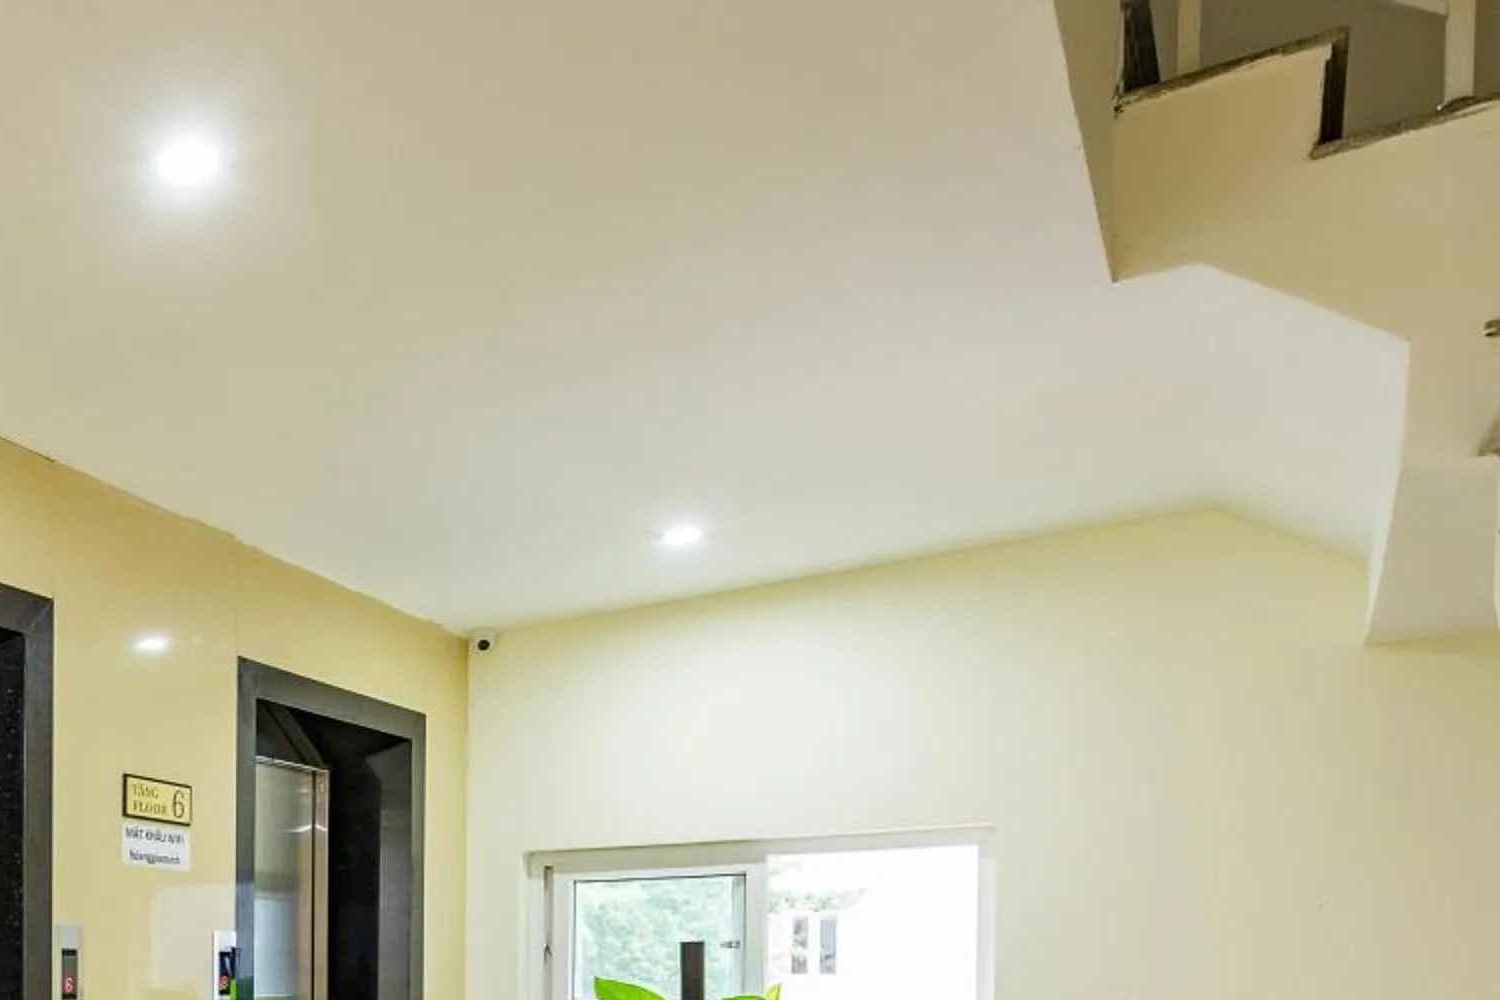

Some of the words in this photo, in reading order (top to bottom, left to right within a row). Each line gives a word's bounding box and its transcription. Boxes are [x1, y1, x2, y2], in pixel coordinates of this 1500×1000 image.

[133, 799, 167, 815] FLOOR
[173, 789, 184, 819] 6
[64, 976, 74, 993] 6
